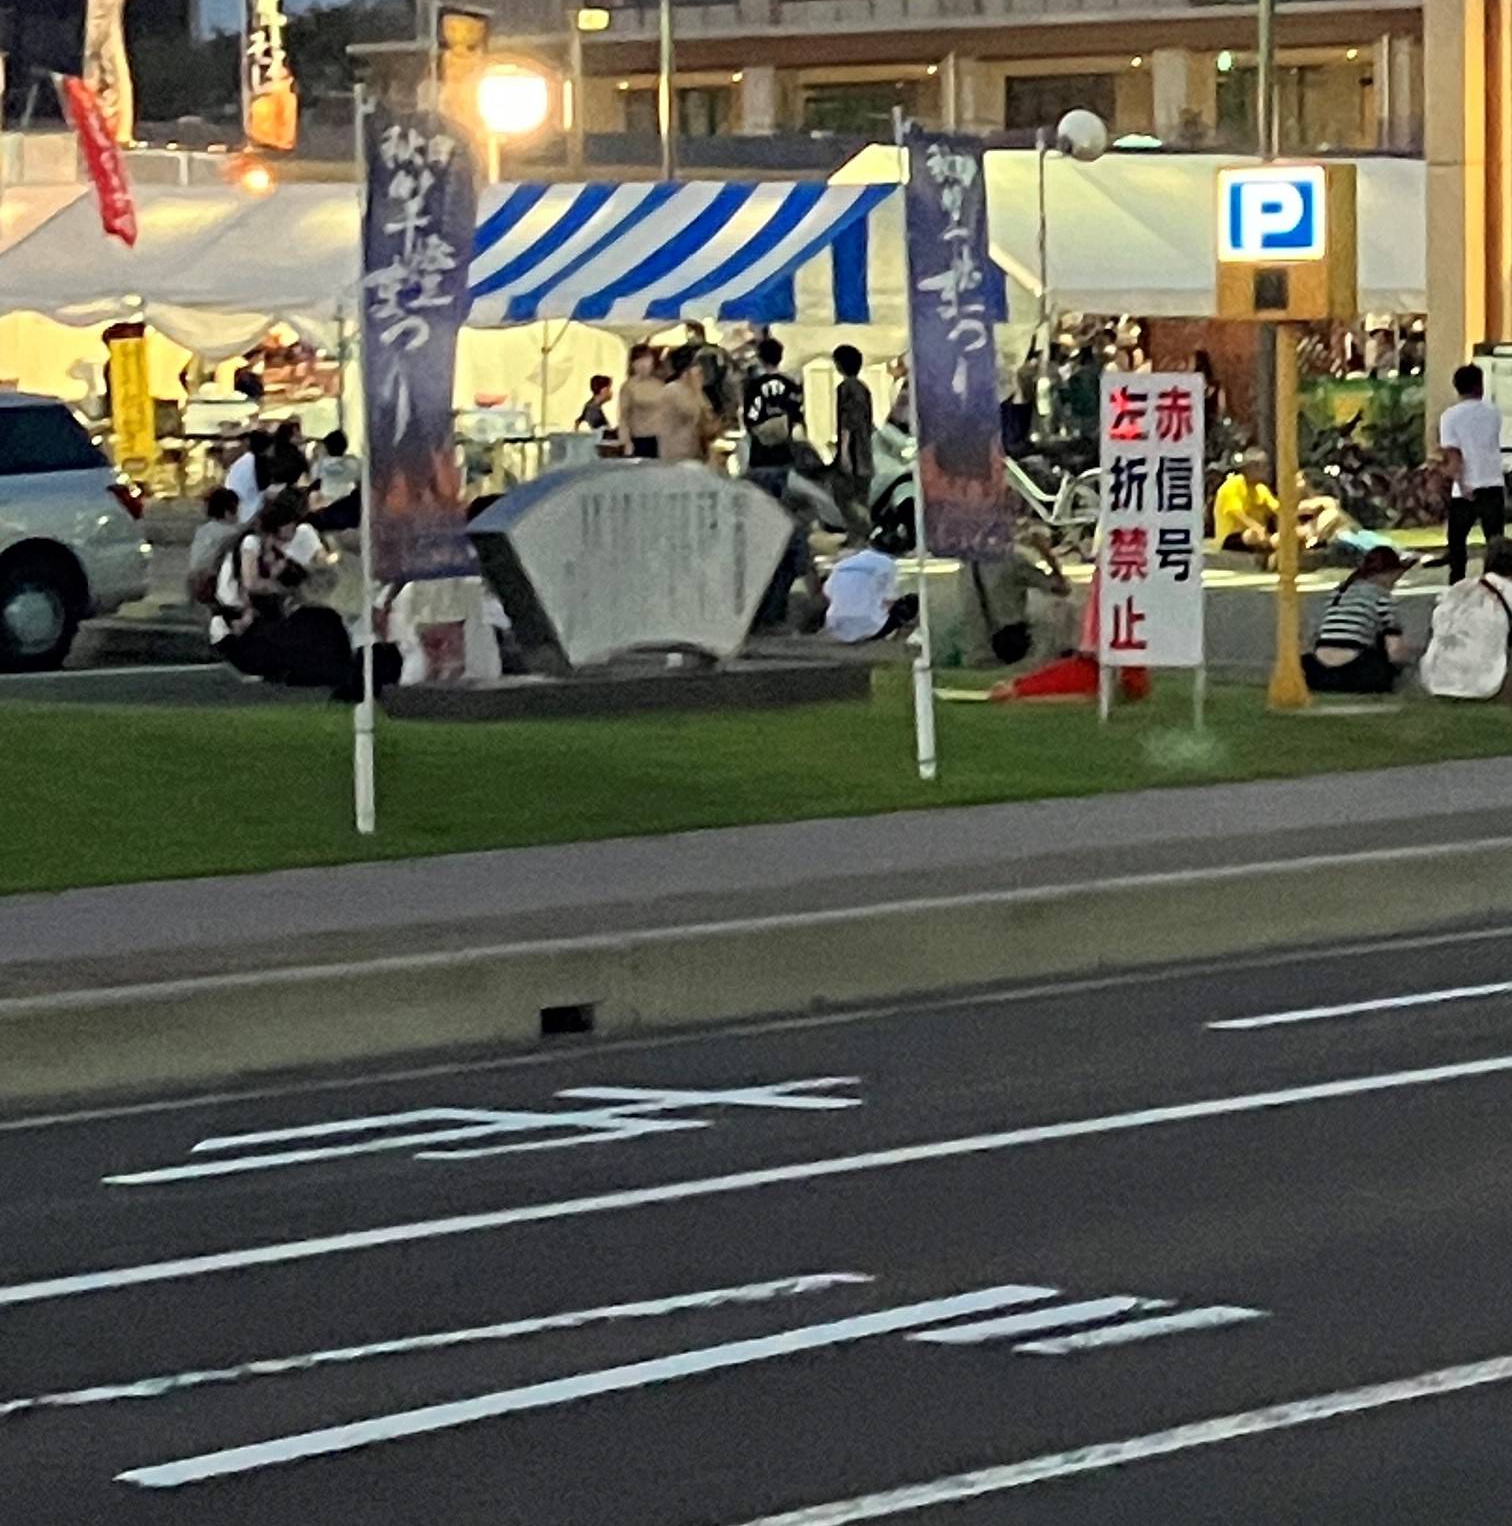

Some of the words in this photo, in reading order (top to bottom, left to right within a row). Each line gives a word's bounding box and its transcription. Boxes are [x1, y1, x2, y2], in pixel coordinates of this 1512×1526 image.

[1240, 181, 1304, 249] P
[1109, 384, 1150, 651] 左折禁止
[1154, 384, 1195, 583] 赤信号
